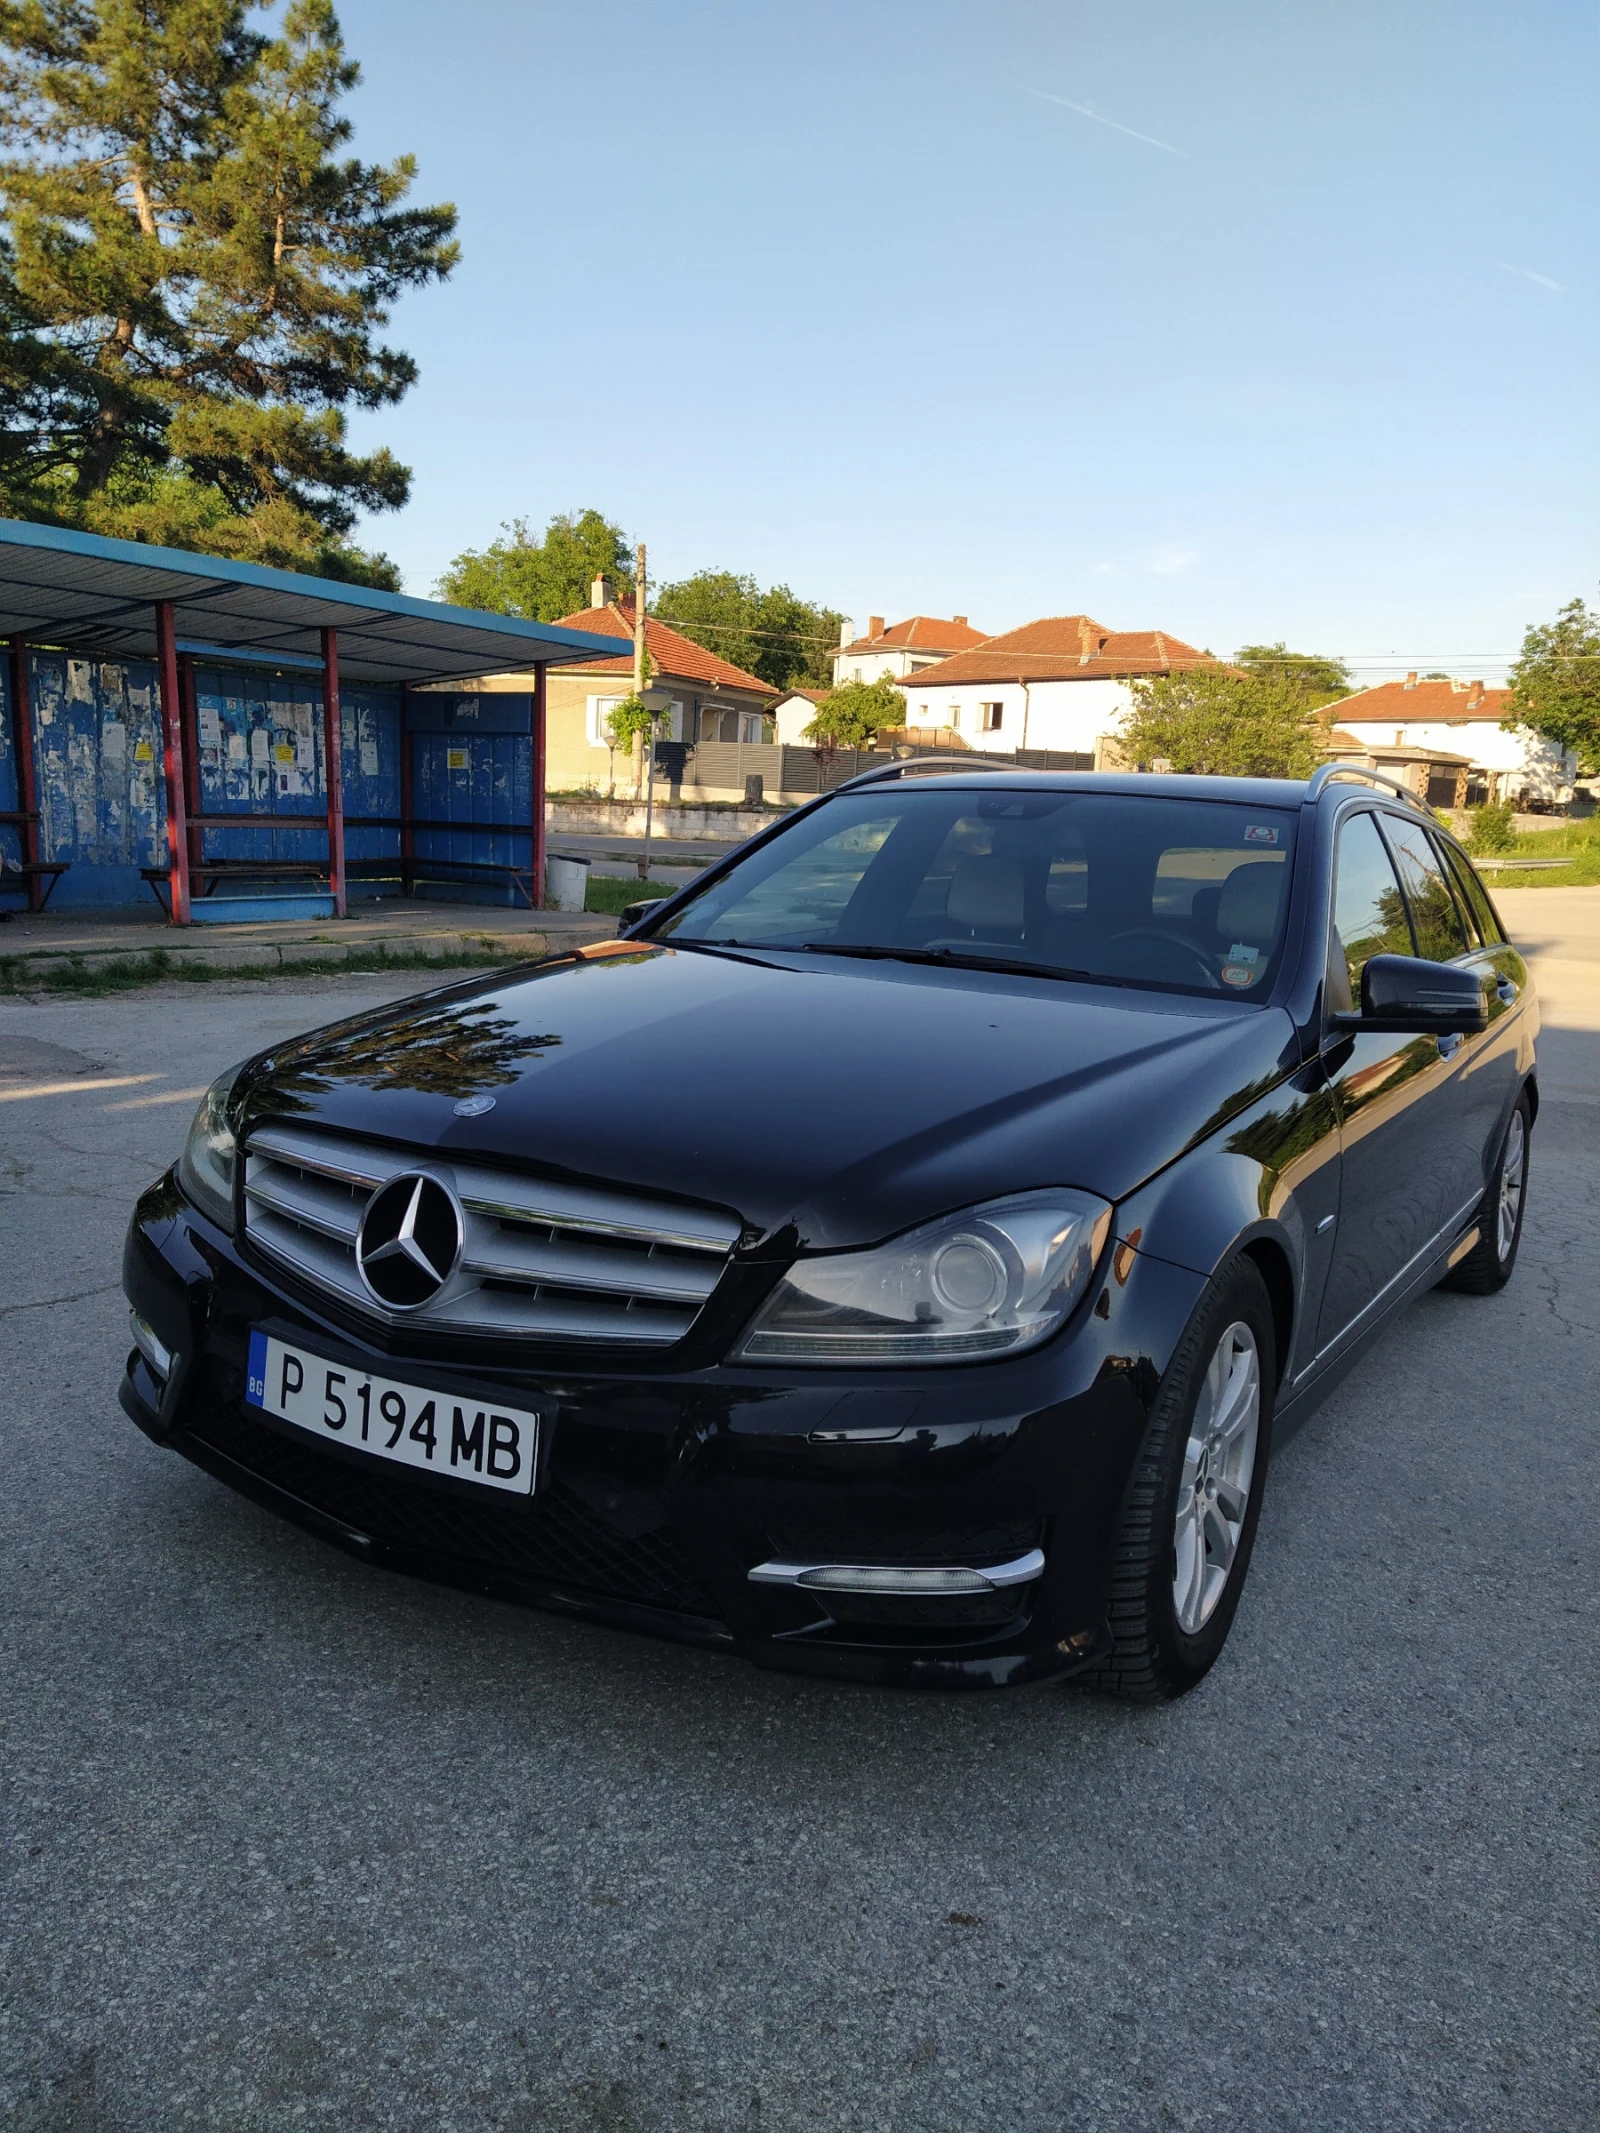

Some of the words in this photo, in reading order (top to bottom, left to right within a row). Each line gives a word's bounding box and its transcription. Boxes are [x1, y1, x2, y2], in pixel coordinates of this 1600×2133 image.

[249, 1376, 263, 1396] BG
[281, 1353, 304, 1410] P
[324, 1370, 437, 1460] 5194
[450, 1406, 521, 1480] MB
